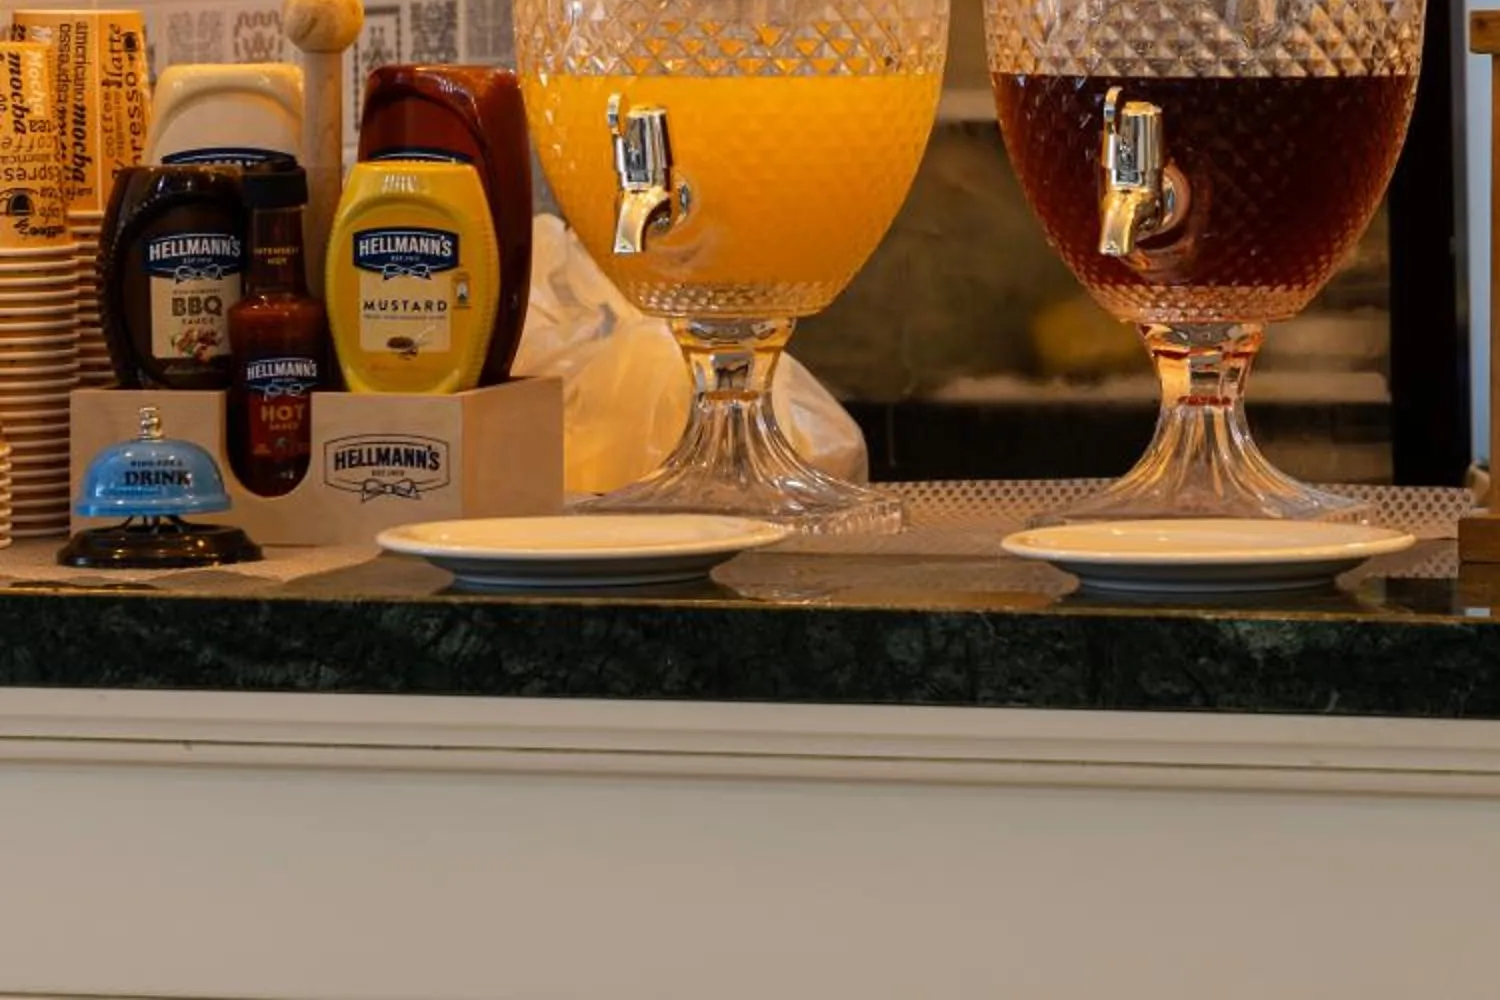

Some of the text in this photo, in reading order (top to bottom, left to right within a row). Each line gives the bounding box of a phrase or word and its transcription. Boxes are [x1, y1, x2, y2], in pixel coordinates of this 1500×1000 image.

[8, 51, 30, 135] mocha
[72, 103, 93, 183] mocha
[149, 235, 241, 261] HELLMANN'S
[359, 235, 453, 257] HELLMANN'S
[171, 295, 222, 316] BBQ
[362, 300, 448, 312] MUSTARD
[246, 360, 318, 381] HELLMANN'S
[261, 403, 304, 422] HOT
[335, 444, 440, 472] HELLMANN'S
[125, 470, 192, 486] DRINK
